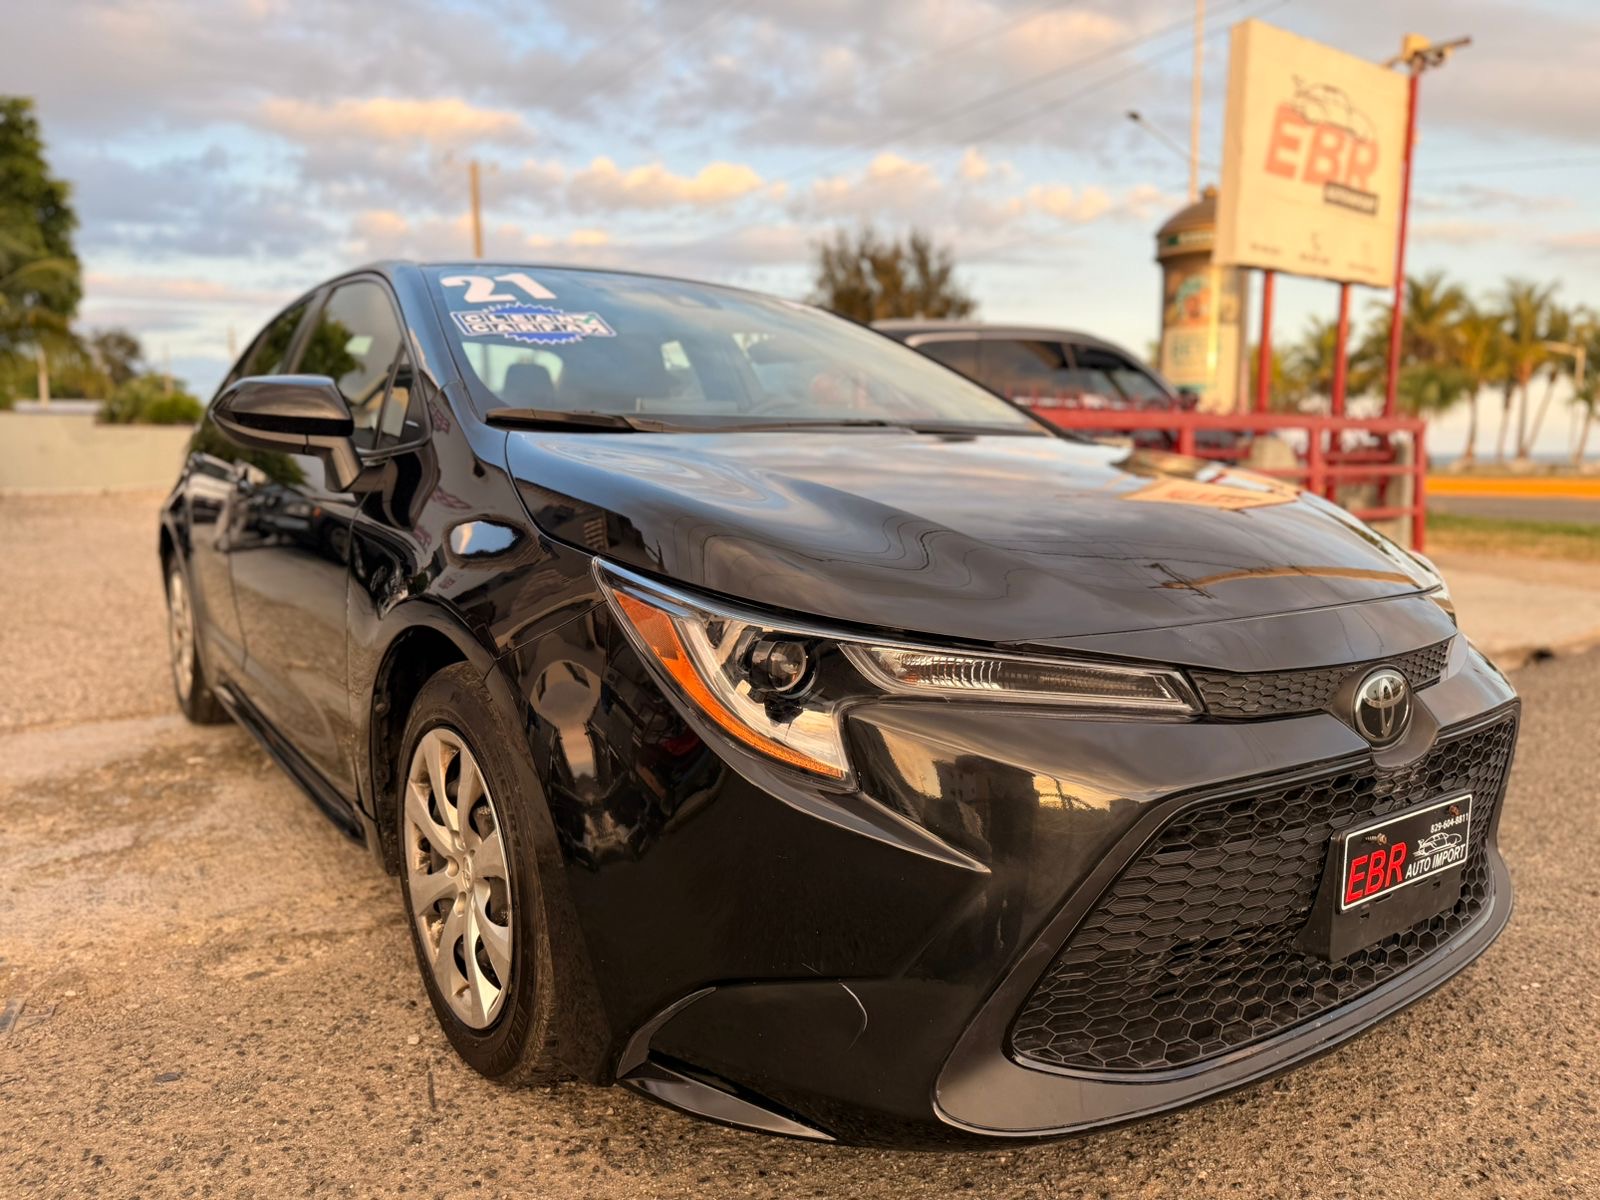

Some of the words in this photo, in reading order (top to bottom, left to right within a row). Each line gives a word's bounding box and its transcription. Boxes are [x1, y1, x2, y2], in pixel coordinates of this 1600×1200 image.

[1264, 102, 1380, 191] EBR
[440, 272, 557, 303] 21
[465, 312, 577, 324] CLEAN
[1430, 813, 1469, 833] 829-604-8811
[1345, 842, 1407, 903] EBR
[1405, 857, 1431, 879] AUTO
[1432, 844, 1466, 869] IMPORT
